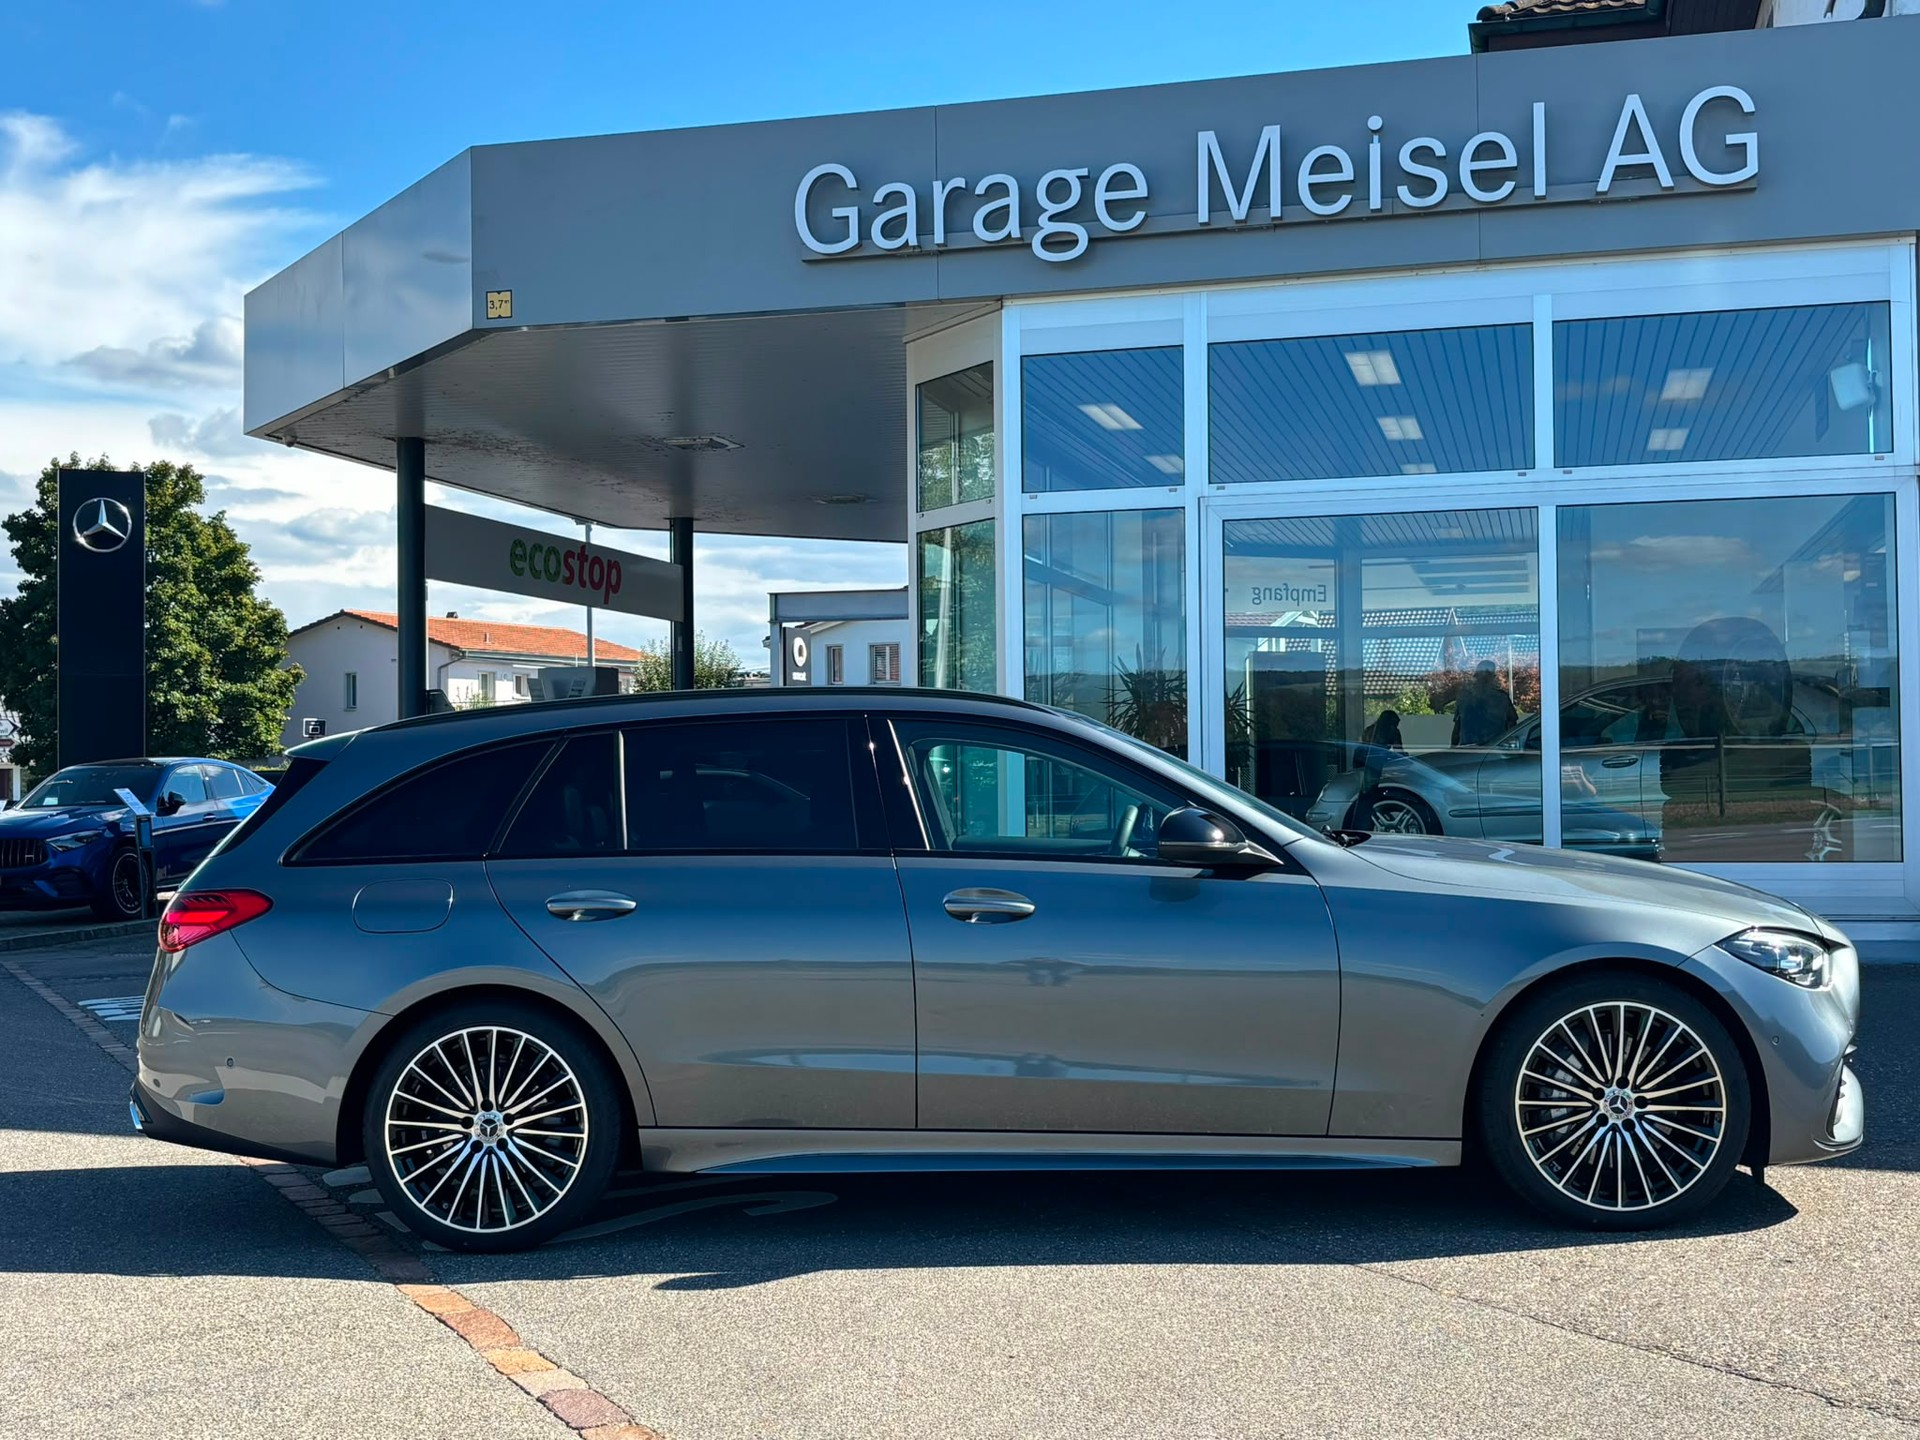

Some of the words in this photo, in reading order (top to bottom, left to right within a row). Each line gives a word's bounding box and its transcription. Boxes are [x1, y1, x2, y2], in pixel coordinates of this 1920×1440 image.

[794, 161, 1149, 262] Garage
[1196, 101, 1547, 225] Meisel
[1596, 85, 1759, 194] AG
[509, 538, 622, 605] ecostop
